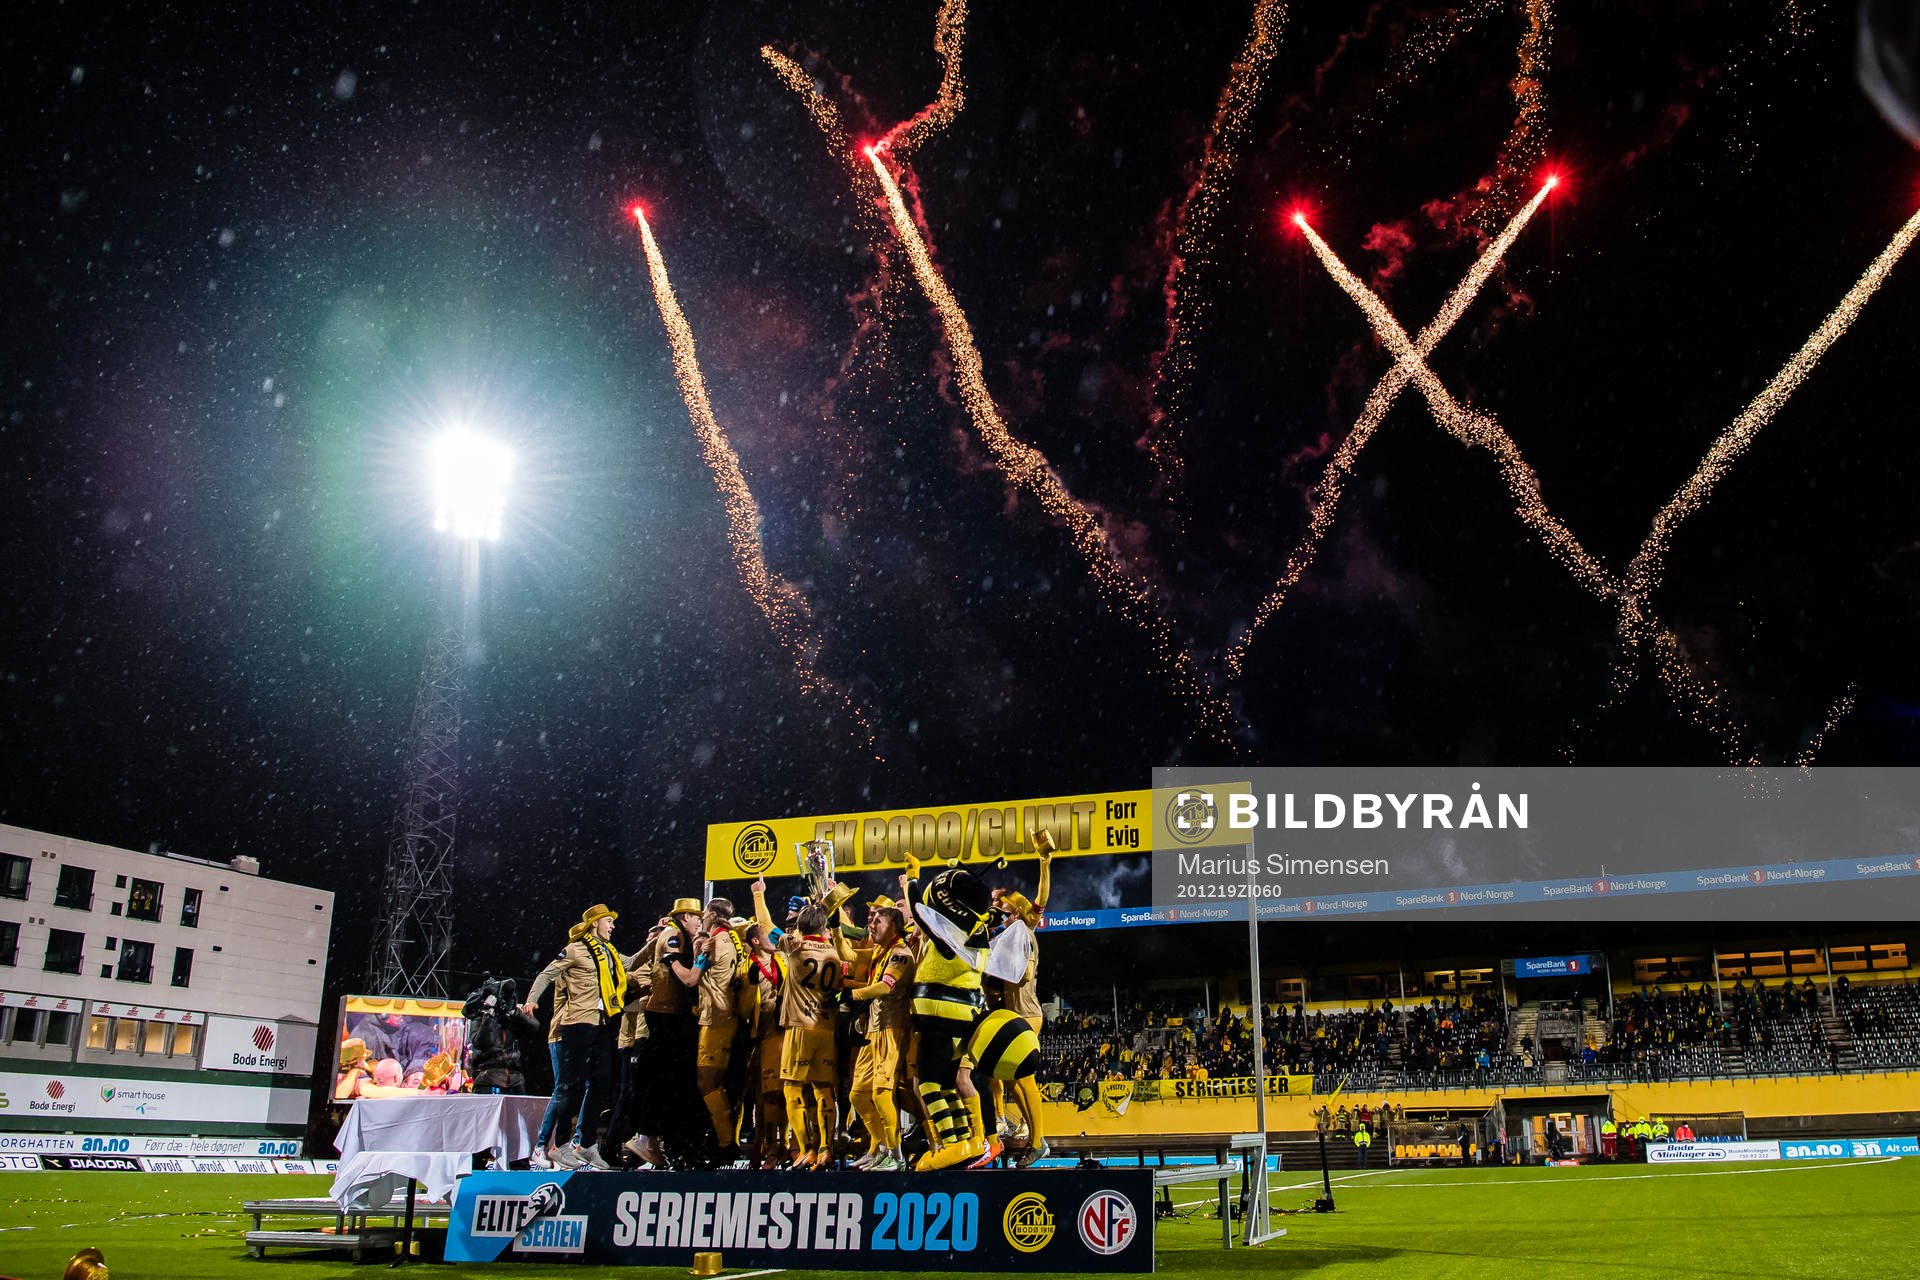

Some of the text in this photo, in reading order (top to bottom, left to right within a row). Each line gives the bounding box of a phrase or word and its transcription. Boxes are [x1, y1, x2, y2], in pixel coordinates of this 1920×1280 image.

[1106, 800, 1137, 820] Førr
[862, 800, 1096, 864] BODØ/GLIMT
[1106, 825, 1139, 848] Evig
[1856, 861, 1911, 875] SpareBank
[1696, 873, 1749, 886] SpareBank
[1767, 868, 1825, 880] Nord-Norge
[1543, 883, 1593, 896] SpareBank
[1610, 880, 1667, 891] Nord-Norge
[1396, 894, 1444, 906] SpareBank
[1460, 889, 1514, 901] Nord-Norge
[1256, 903, 1301, 915] SpareBank
[1317, 900, 1368, 910] Nord-Norge
[1049, 916, 1096, 927] Nord-Norge
[1121, 912, 1165, 923] SpareBank
[1179, 908, 1229, 919] Nord-Norge
[1526, 960, 1566, 970] SpareBank
[800, 957, 837, 993] 20
[233, 1053, 288, 1071] Bodø Energi
[118, 1090, 166, 1100] smart house
[30, 1101, 76, 1113] Bodø Energi
[82, 1137, 130, 1152] an.no
[144, 1139, 166, 1151] Førr
[190, 1140, 209, 1151] hele
[211, 1141, 245, 1154] døgnet!
[258, 1142, 297, 1155] an.no
[1785, 1144, 1842, 1157] an.no
[1886, 1144, 1900, 1152] Alt
[1656, 1151, 1705, 1159] Minilager
[69, 1158, 137, 1170] DIADORA
[150, 1160, 182, 1172] Løvold
[193, 1160, 225, 1172] Løvold
[237, 1161, 267, 1172] Løvold
[476, 1200, 529, 1232] ELITE
[613, 1191, 980, 1251] SERIEMESTER 2020
[521, 1220, 582, 1248] SERIEN
